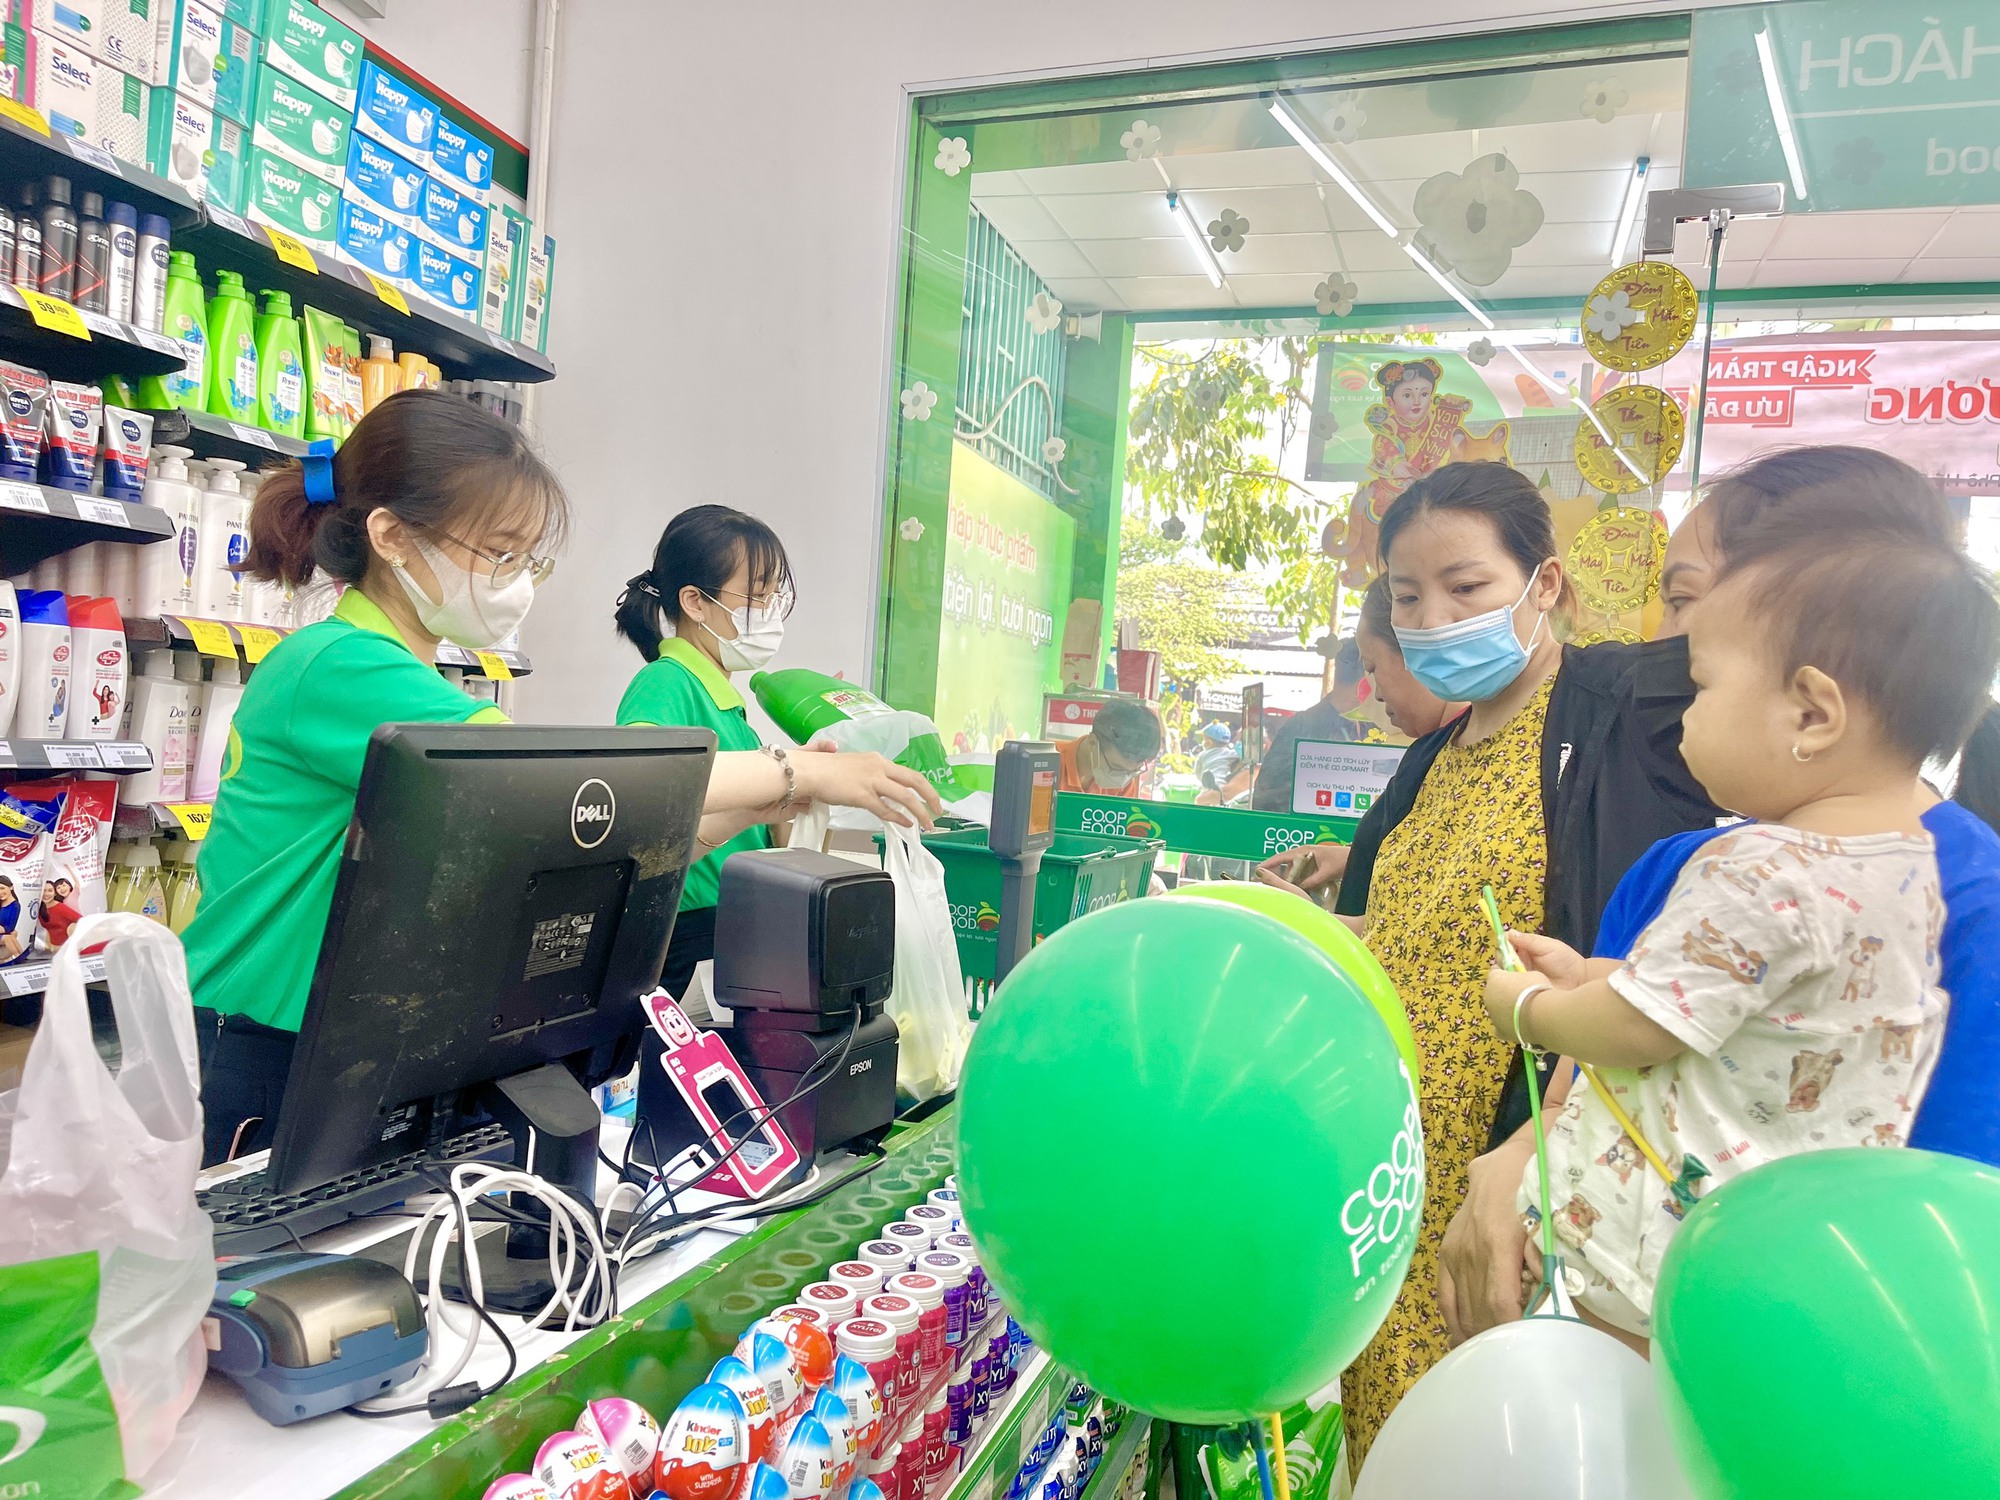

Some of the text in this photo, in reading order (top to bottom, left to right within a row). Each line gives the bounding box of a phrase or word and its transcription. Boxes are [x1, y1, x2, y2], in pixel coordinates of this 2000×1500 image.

[187, 12, 217, 38] Select
[288, 8, 327, 38] Happy
[51, 56, 92, 86] Select
[273, 89, 313, 117] Happy
[376, 81, 409, 107] Happy
[176, 110, 206, 134] Select
[438, 127, 467, 150] Happy
[361, 151, 394, 174] Happy
[264, 169, 301, 195] Happy
[429, 191, 458, 212] Happy
[350, 216, 384, 239] Happy
[422, 255, 451, 274] Happy
[1436, 409, 1459, 425] Vạn
[949, 499, 973, 548] háp
[944, 569, 973, 621] tiện
[1001, 590, 1024, 631] tươi
[1026, 610, 1053, 646] ngon
[576, 804, 611, 823] DELL
[1081, 821, 1126, 836] FOOD
[849, 1058, 872, 1077] EPSON
[1350, 1141, 1424, 1278] FOOD
[851, 1323, 883, 1333] XYLITOL
